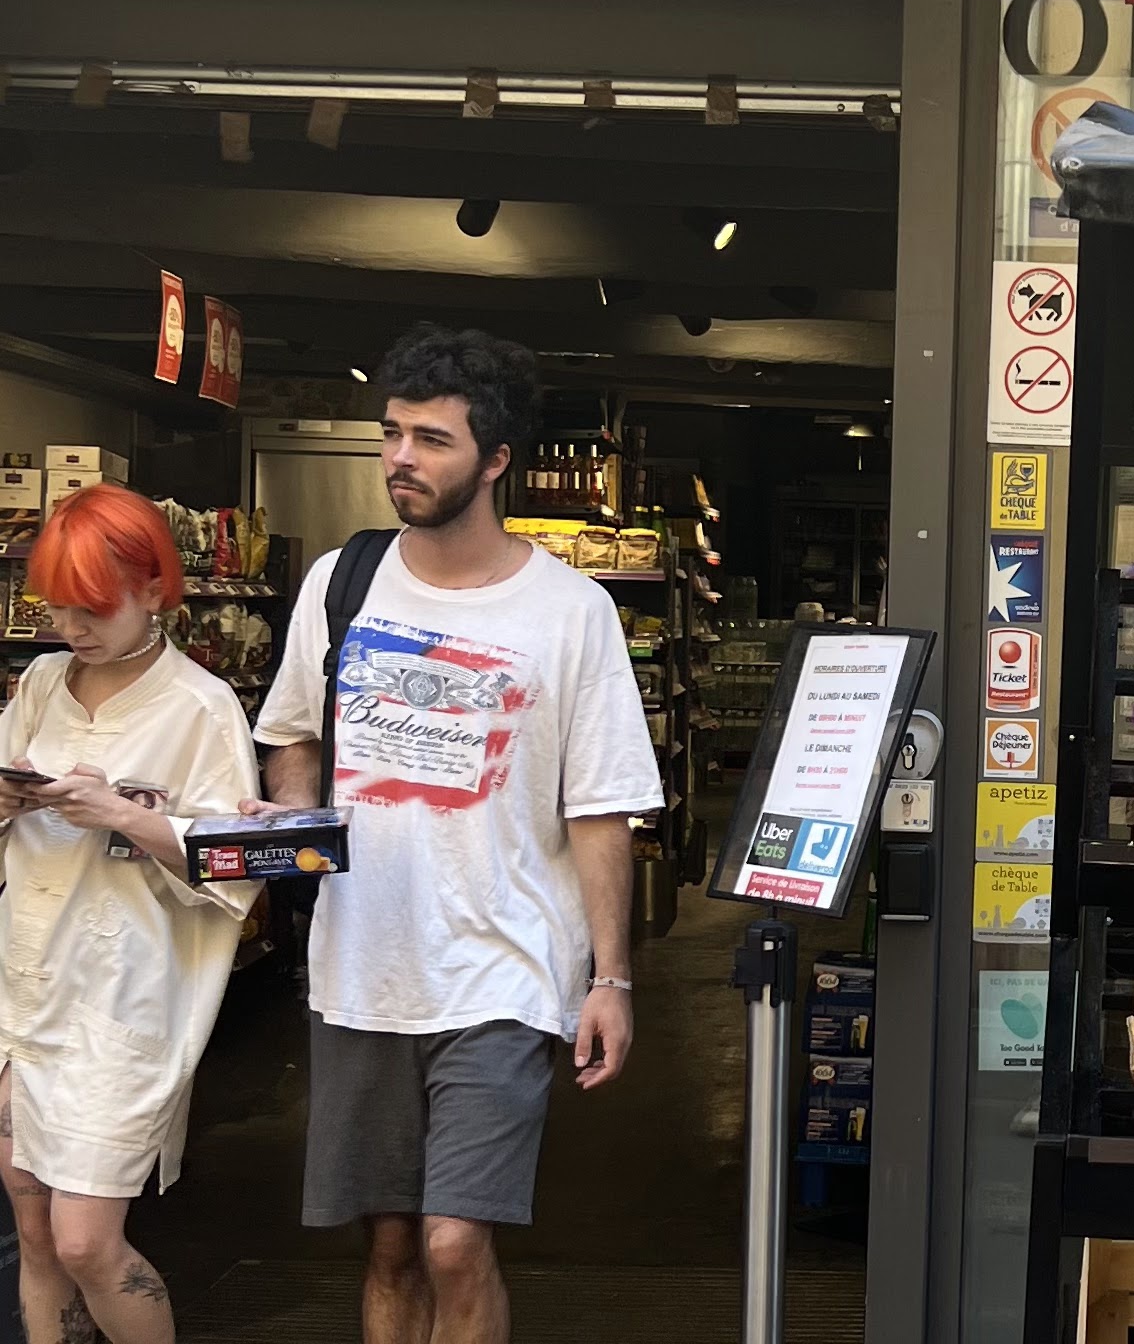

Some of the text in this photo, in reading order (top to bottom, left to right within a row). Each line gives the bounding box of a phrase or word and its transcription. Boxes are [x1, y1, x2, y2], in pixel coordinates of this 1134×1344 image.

[1008, 510, 1037, 521] TABLE
[993, 672, 1028, 684] Ticket
[340, 692, 488, 747] Budweiser
[995, 732, 1029, 742] Chèque
[815, 744, 853, 753] DIMANCHE
[990, 785, 1048, 802] apetiz
[761, 821, 794, 842] Uber
[244, 848, 297, 860] GALETTES
[755, 840, 787, 860] Eats
[991, 866, 1039, 880] chèque
[751, 874, 777, 886] Service
[991, 881, 1038, 893] de Table
[1000, 1044, 1012, 1052] Too
[1014, 1043, 1035, 1052] Good
